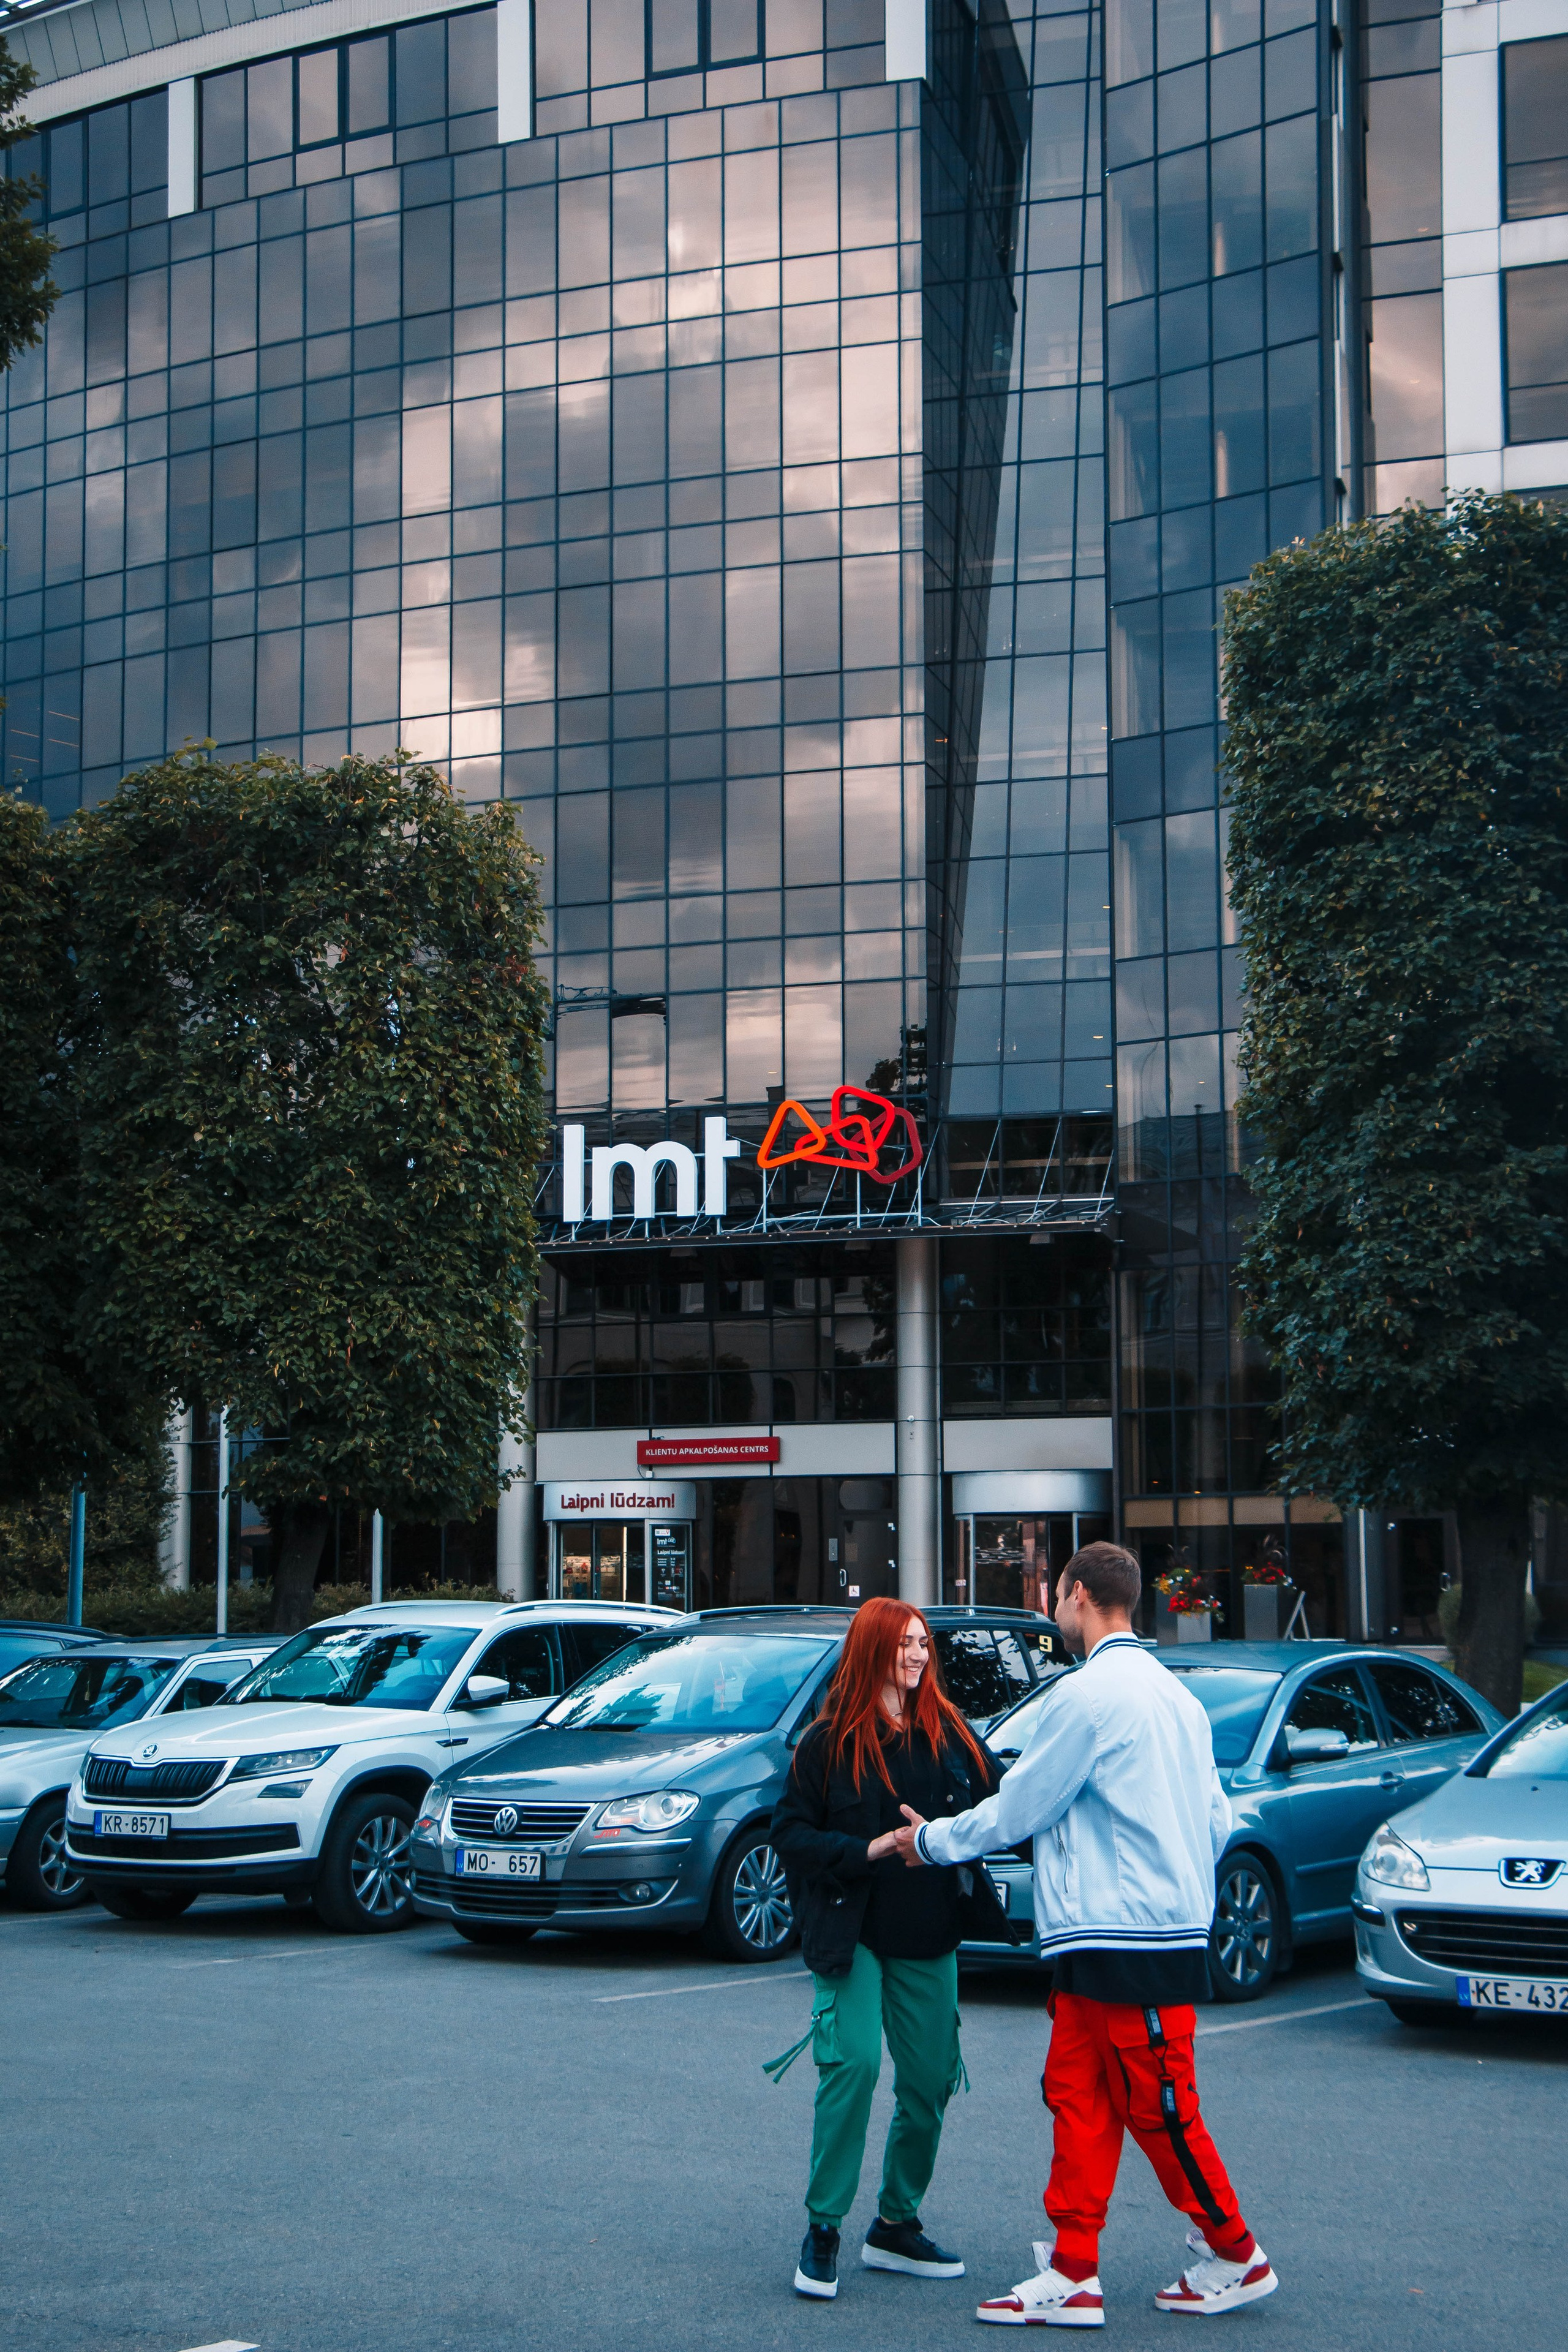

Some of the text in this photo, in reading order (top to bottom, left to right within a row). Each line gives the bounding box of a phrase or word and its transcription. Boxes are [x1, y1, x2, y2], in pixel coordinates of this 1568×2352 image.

[564, 1116, 741, 1223] lmt
[679, 1445, 738, 1455] APKALPOŠANAS
[561, 1493, 675, 1512] Laipni lūdzam!
[1039, 1635, 1053, 1653] 9
[104, 1815, 165, 1834] KR-8571
[509, 1855, 538, 1875] 657
